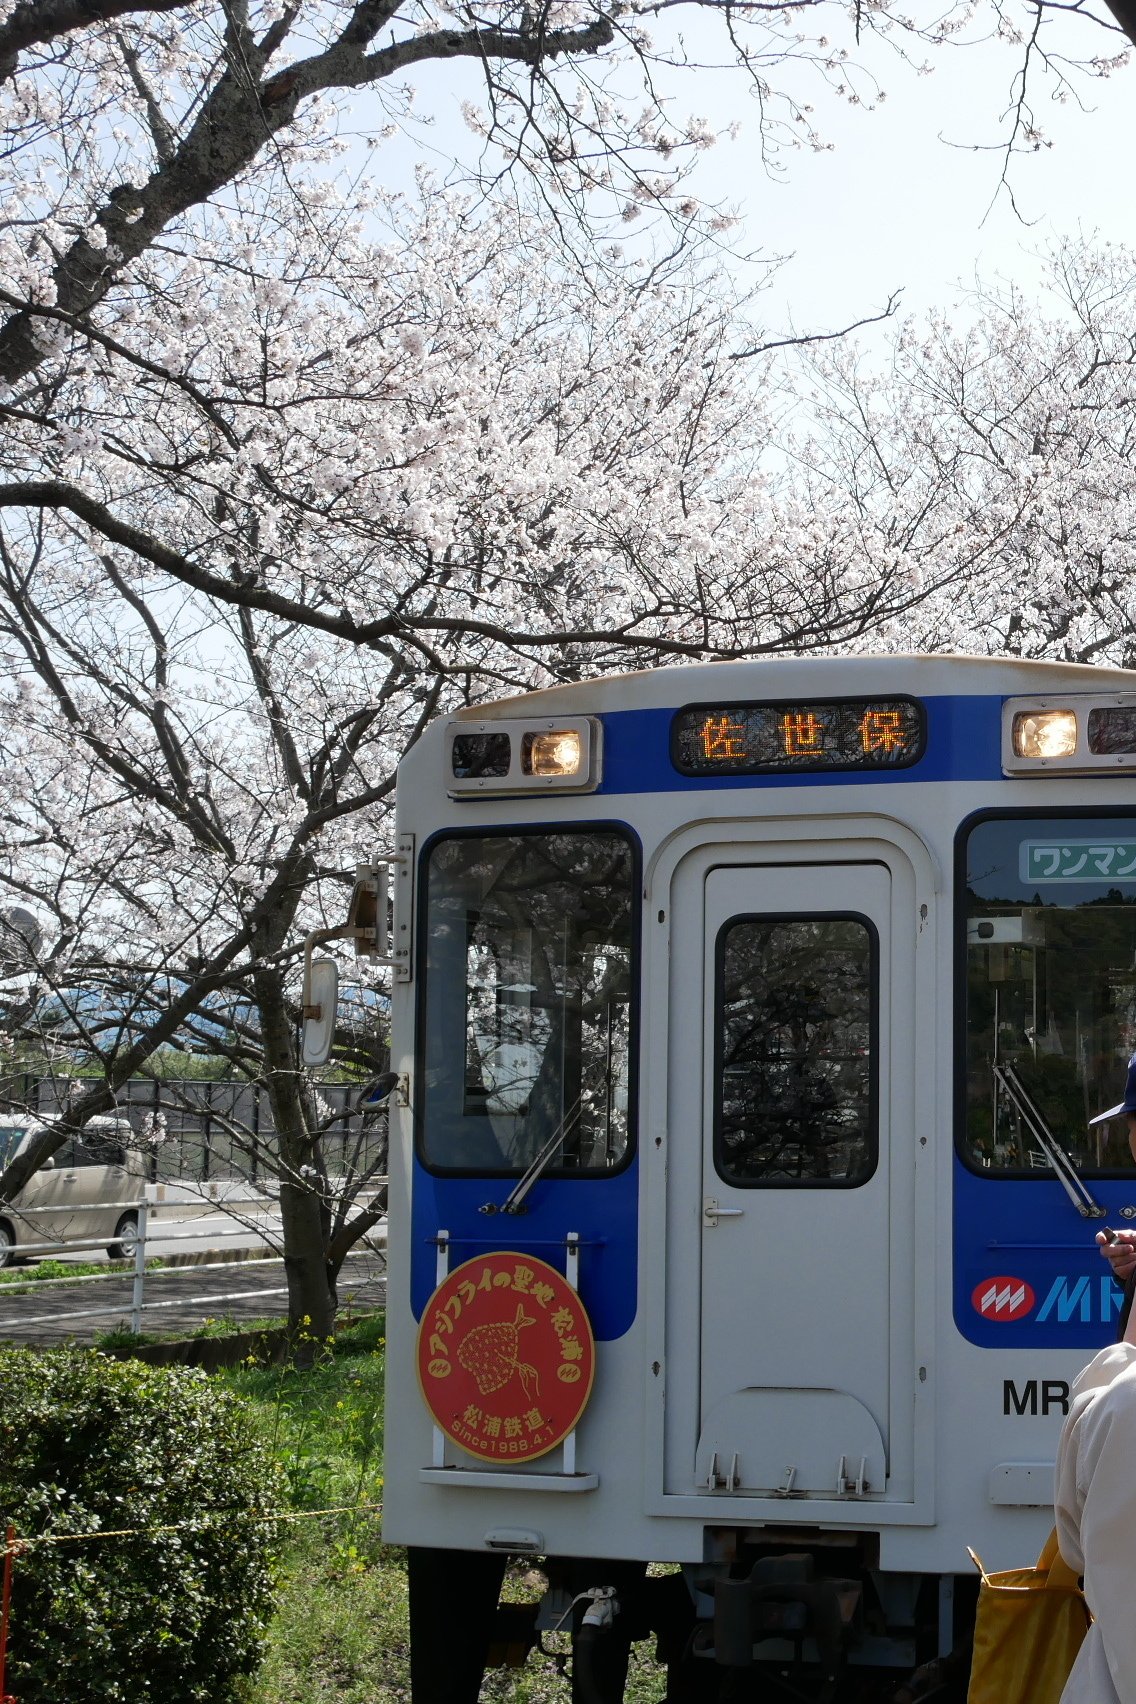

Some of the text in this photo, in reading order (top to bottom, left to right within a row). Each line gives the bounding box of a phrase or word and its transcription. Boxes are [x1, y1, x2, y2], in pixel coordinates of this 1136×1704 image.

[700, 711, 906, 758] 佐世保
[428, 1265, 583, 1361] アジフライの聖地 松浦
[1003, 1380, 1070, 1416] MR
[463, 1404, 544, 1438] 松浦鉄道
